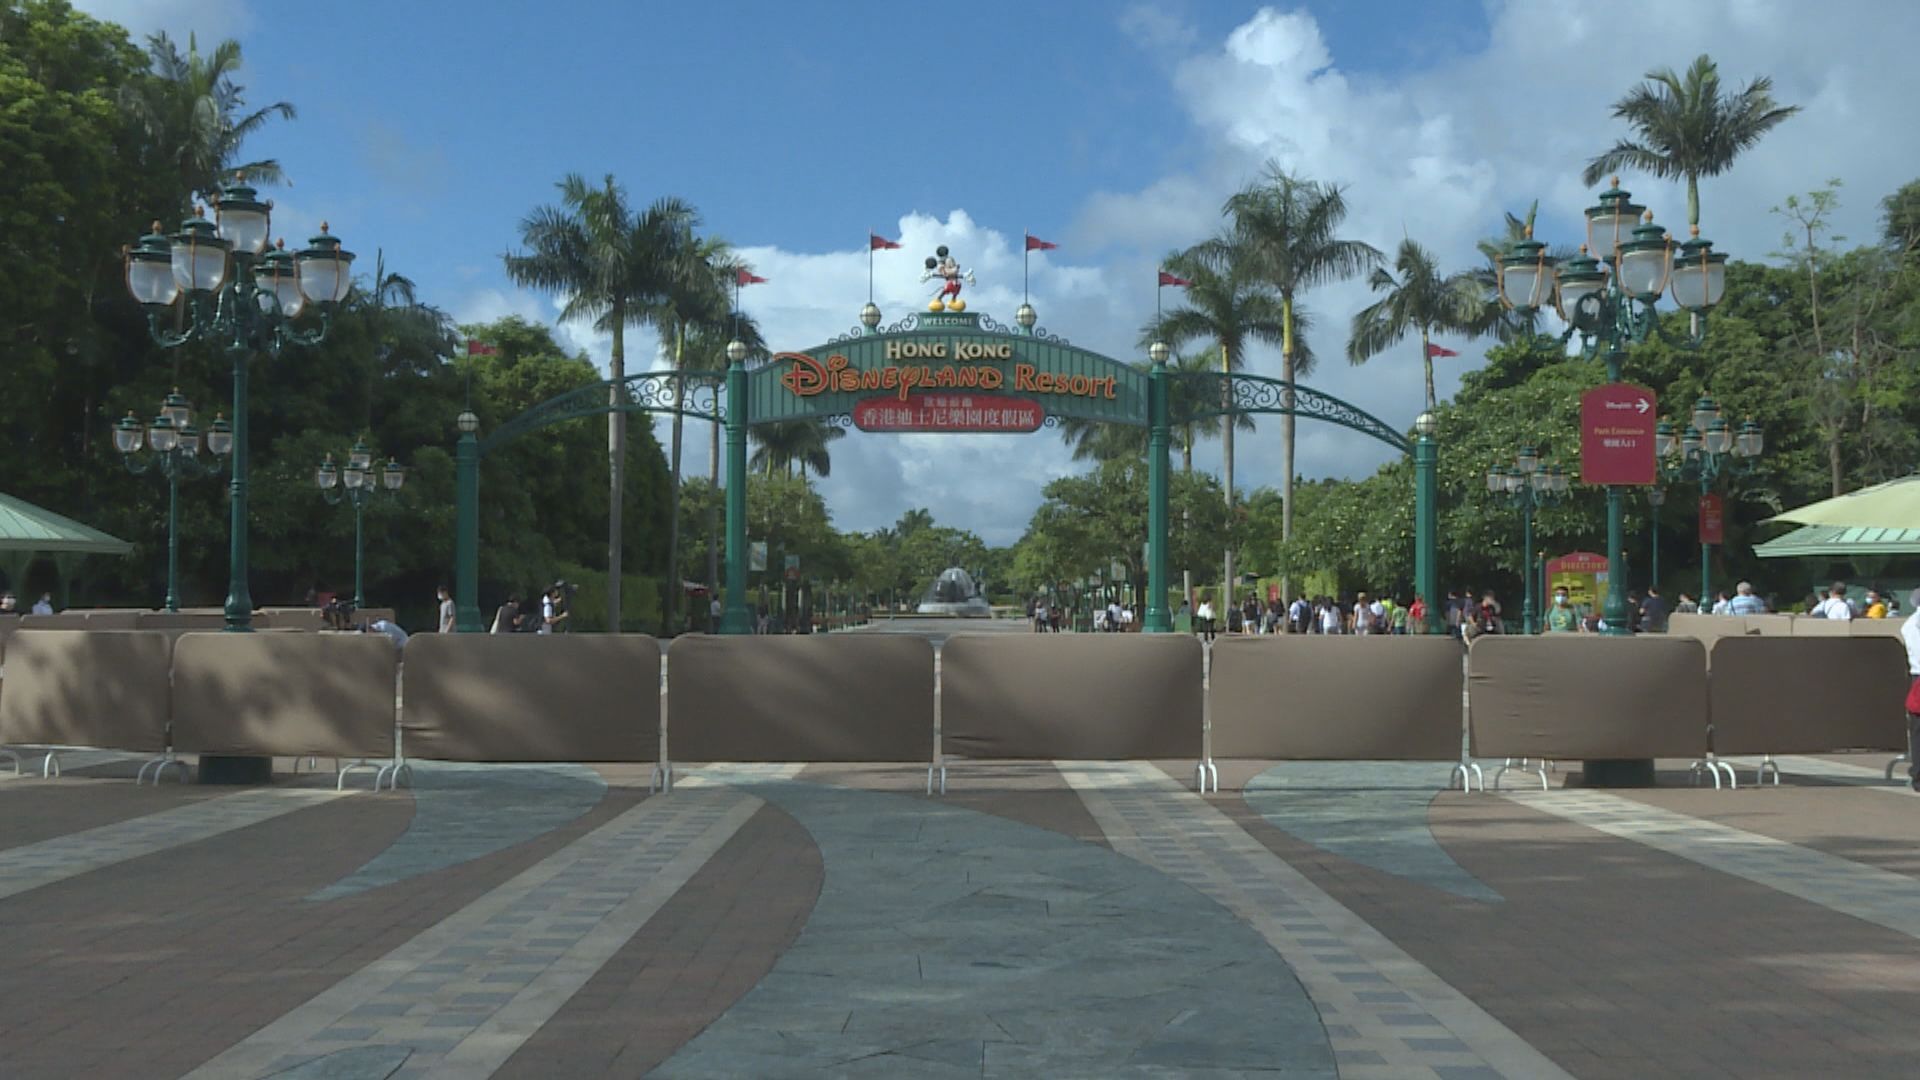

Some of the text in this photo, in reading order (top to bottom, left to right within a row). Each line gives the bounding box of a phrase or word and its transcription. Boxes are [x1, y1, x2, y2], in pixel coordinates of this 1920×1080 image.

[923, 317, 973, 326] WELCOME
[886, 341, 1011, 361] HONG KONG
[1015, 364, 1117, 399] Resort
[862, 407, 1035, 427] 香港迪士尼樂園度假區
